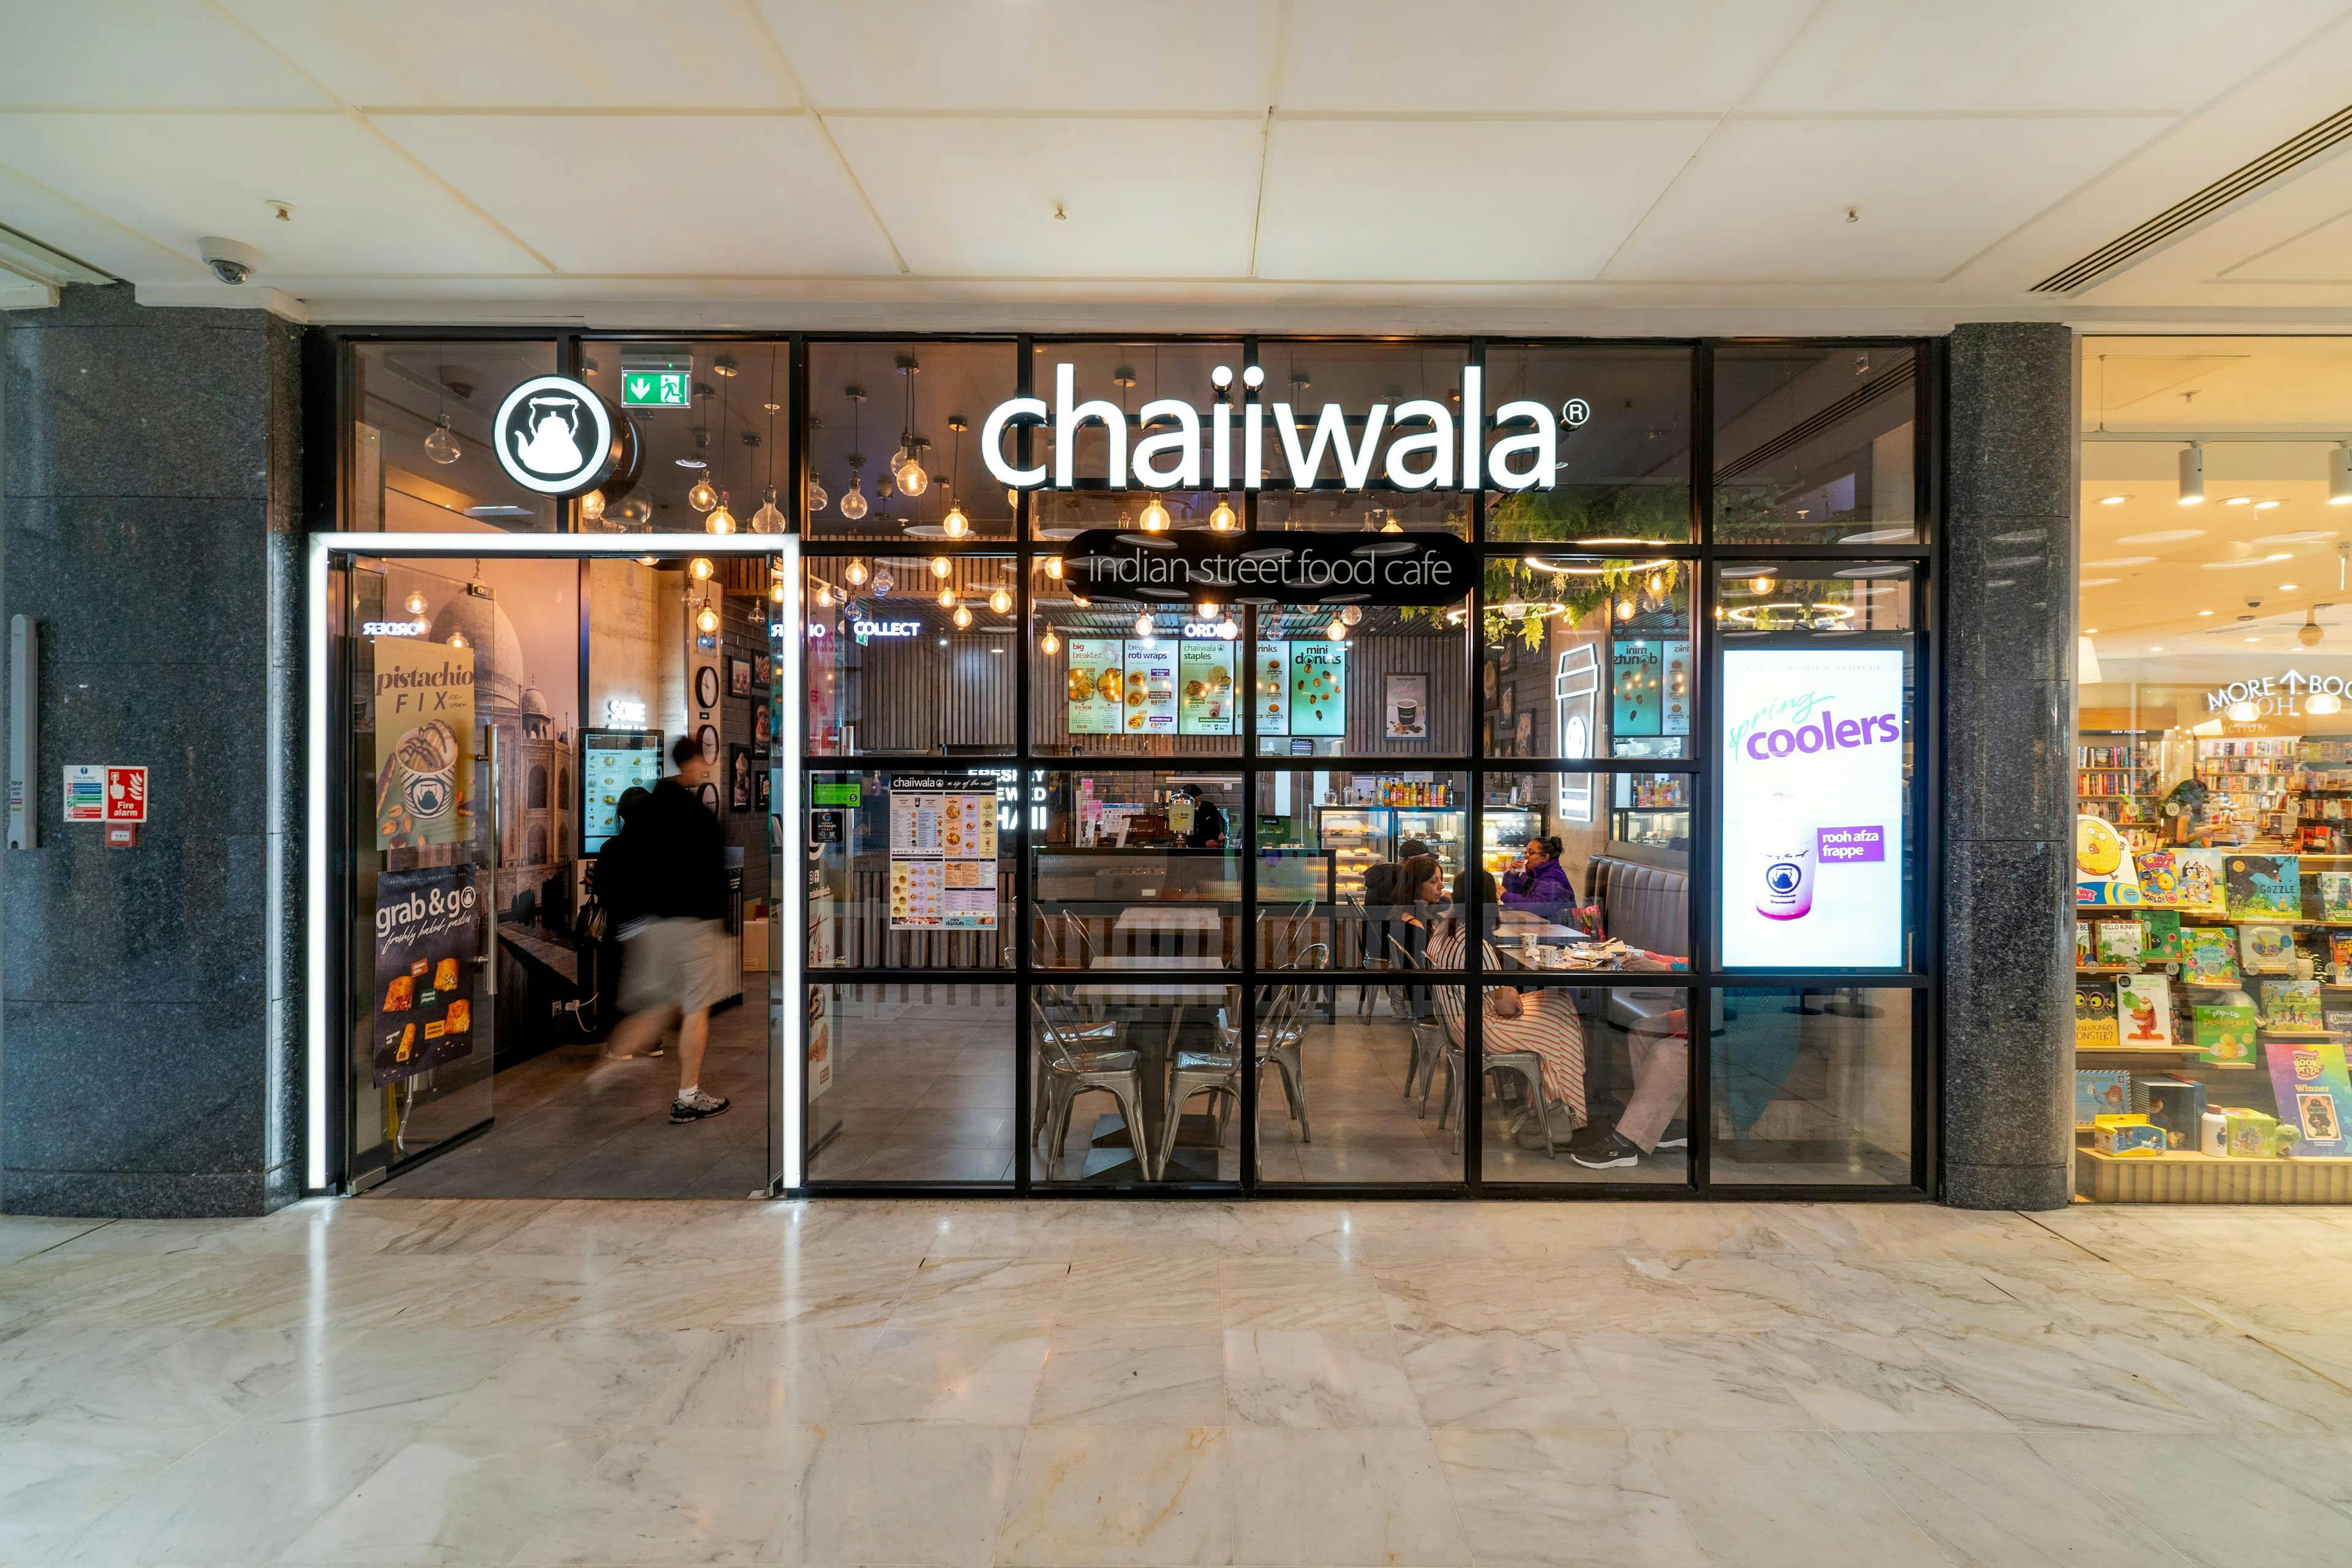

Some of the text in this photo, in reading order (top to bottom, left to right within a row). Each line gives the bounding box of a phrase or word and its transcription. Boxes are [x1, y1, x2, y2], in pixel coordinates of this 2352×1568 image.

[981, 363, 1557, 491] chaiiwala
[1090, 548, 1452, 586] indian street food cafe
[853, 621, 921, 636] COLLECT
[1072, 643, 1084, 652] big
[1306, 645, 1328, 654] mini
[1184, 652, 1212, 661] staples
[375, 661, 474, 696] pistachio
[2207, 677, 2275, 710] MORE
[1729, 691, 1835, 763] spring
[1747, 710, 1899, 760] coolers
[893, 777, 936, 788] chaiiwala
[1822, 829, 1879, 843] rooh afza
[1822, 845, 1864, 859] frappe
[2260, 884, 2296, 894] GOZZLE
[2142, 893, 2165, 903] WORLD!
[375, 892, 426, 938] grab
[428, 888, 445, 916] &
[382, 910, 472, 956] freshly baked pasties
[2076, 1031, 2113, 1041] ONSTER?
